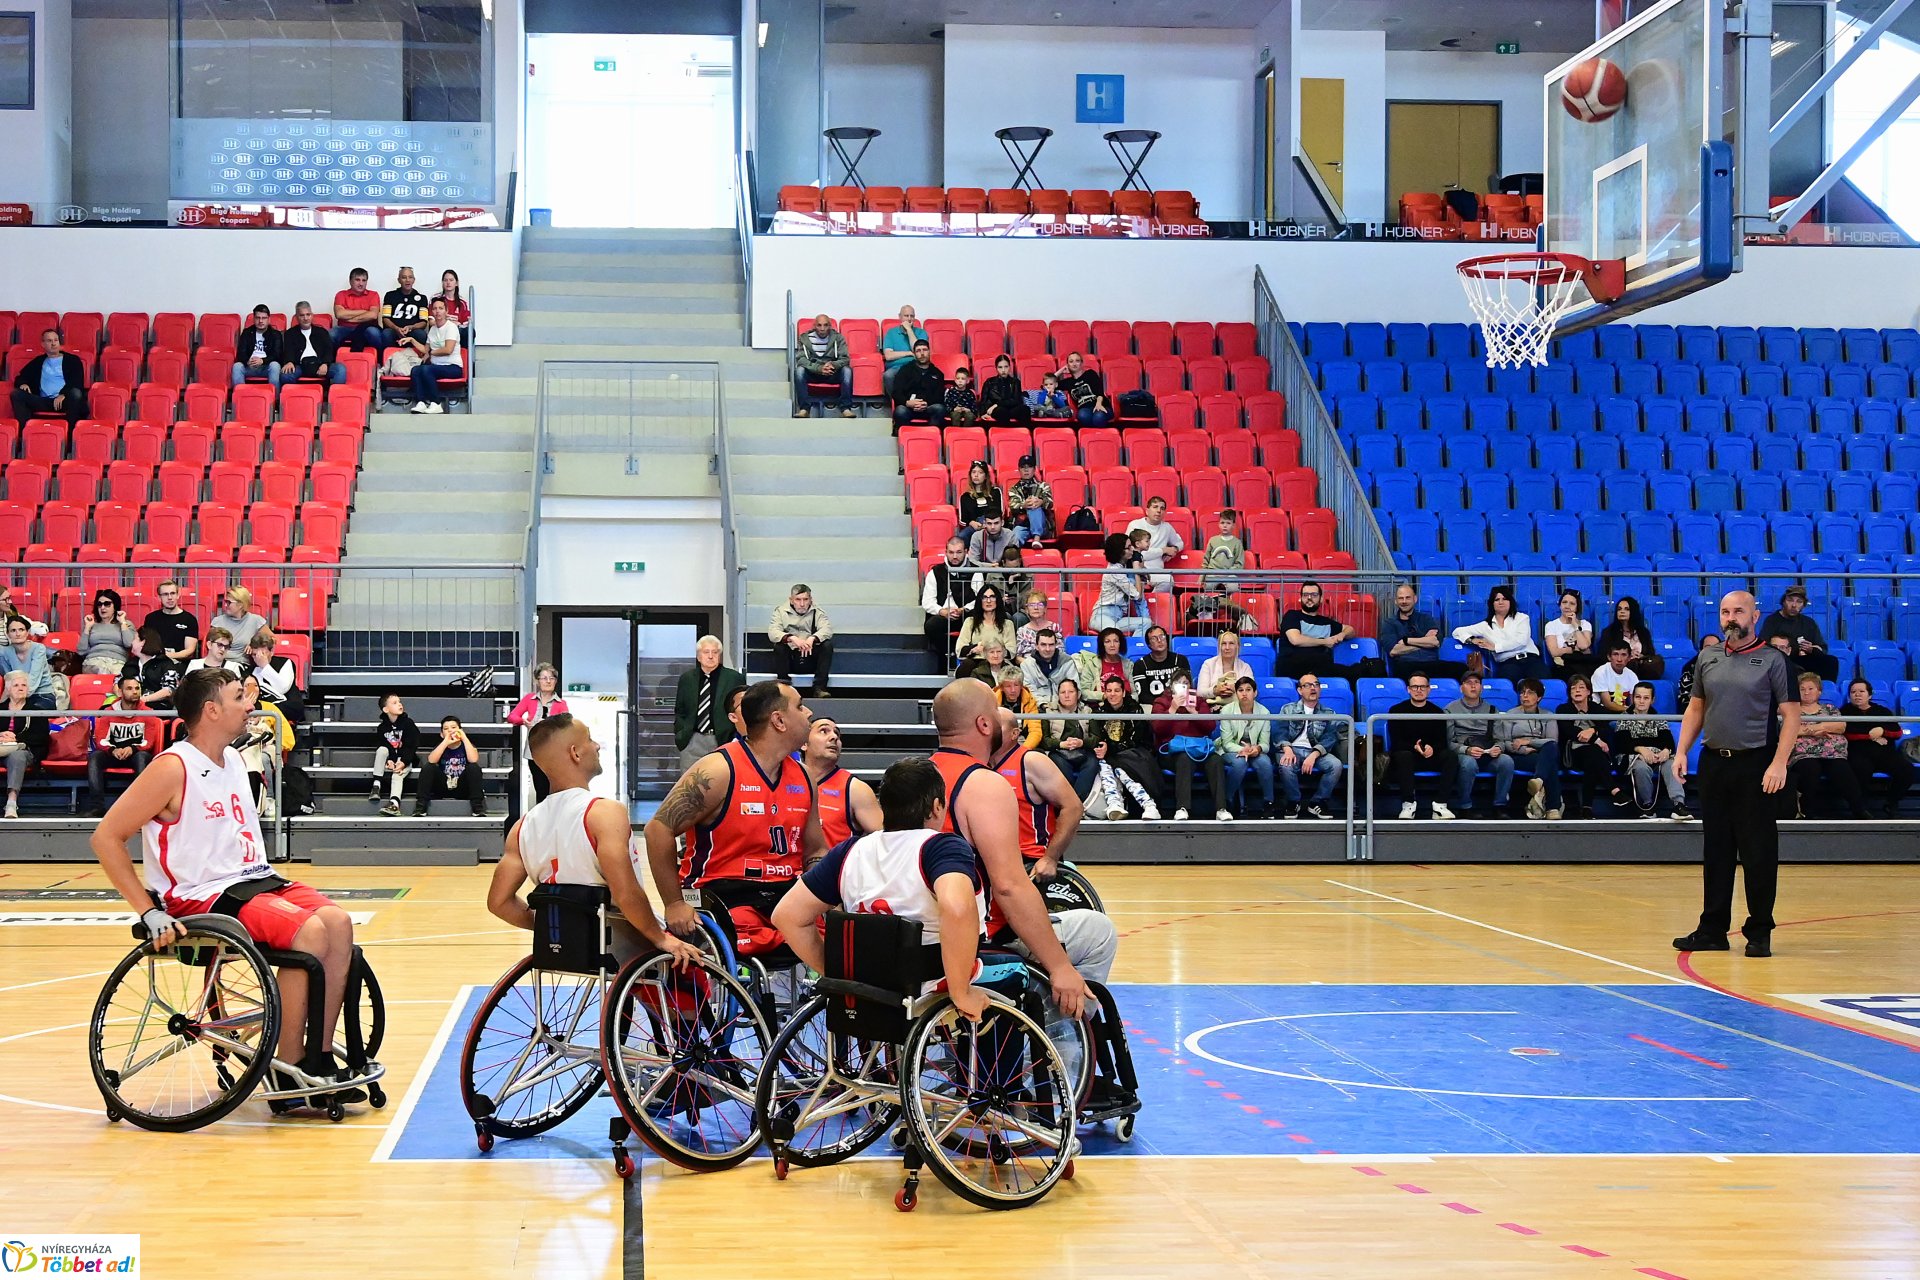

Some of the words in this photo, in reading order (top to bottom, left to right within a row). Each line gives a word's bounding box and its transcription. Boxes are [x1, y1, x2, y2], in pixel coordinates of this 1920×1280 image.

[60, 208, 82, 220] BH
[112, 206, 141, 215] Holding
[178, 210, 200, 222] BH
[220, 216, 250, 224] Csoport
[1034, 222, 1092, 234] HÜBNER
[1151, 222, 1210, 236] HÜBNER
[1268, 225, 1326, 237] HÜBNER
[1386, 226, 1442, 238] HÜBNER
[1500, 227, 1538, 239] HÜBN
[1844, 230, 1901, 242] HÜBNER
[113, 724, 142, 738] NIKE
[740, 784, 761, 792] hama
[231, 794, 244, 824] 6
[768, 824, 788, 856] 10
[766, 864, 793, 876] BRD
[684, 894, 700, 902] DEKRA
